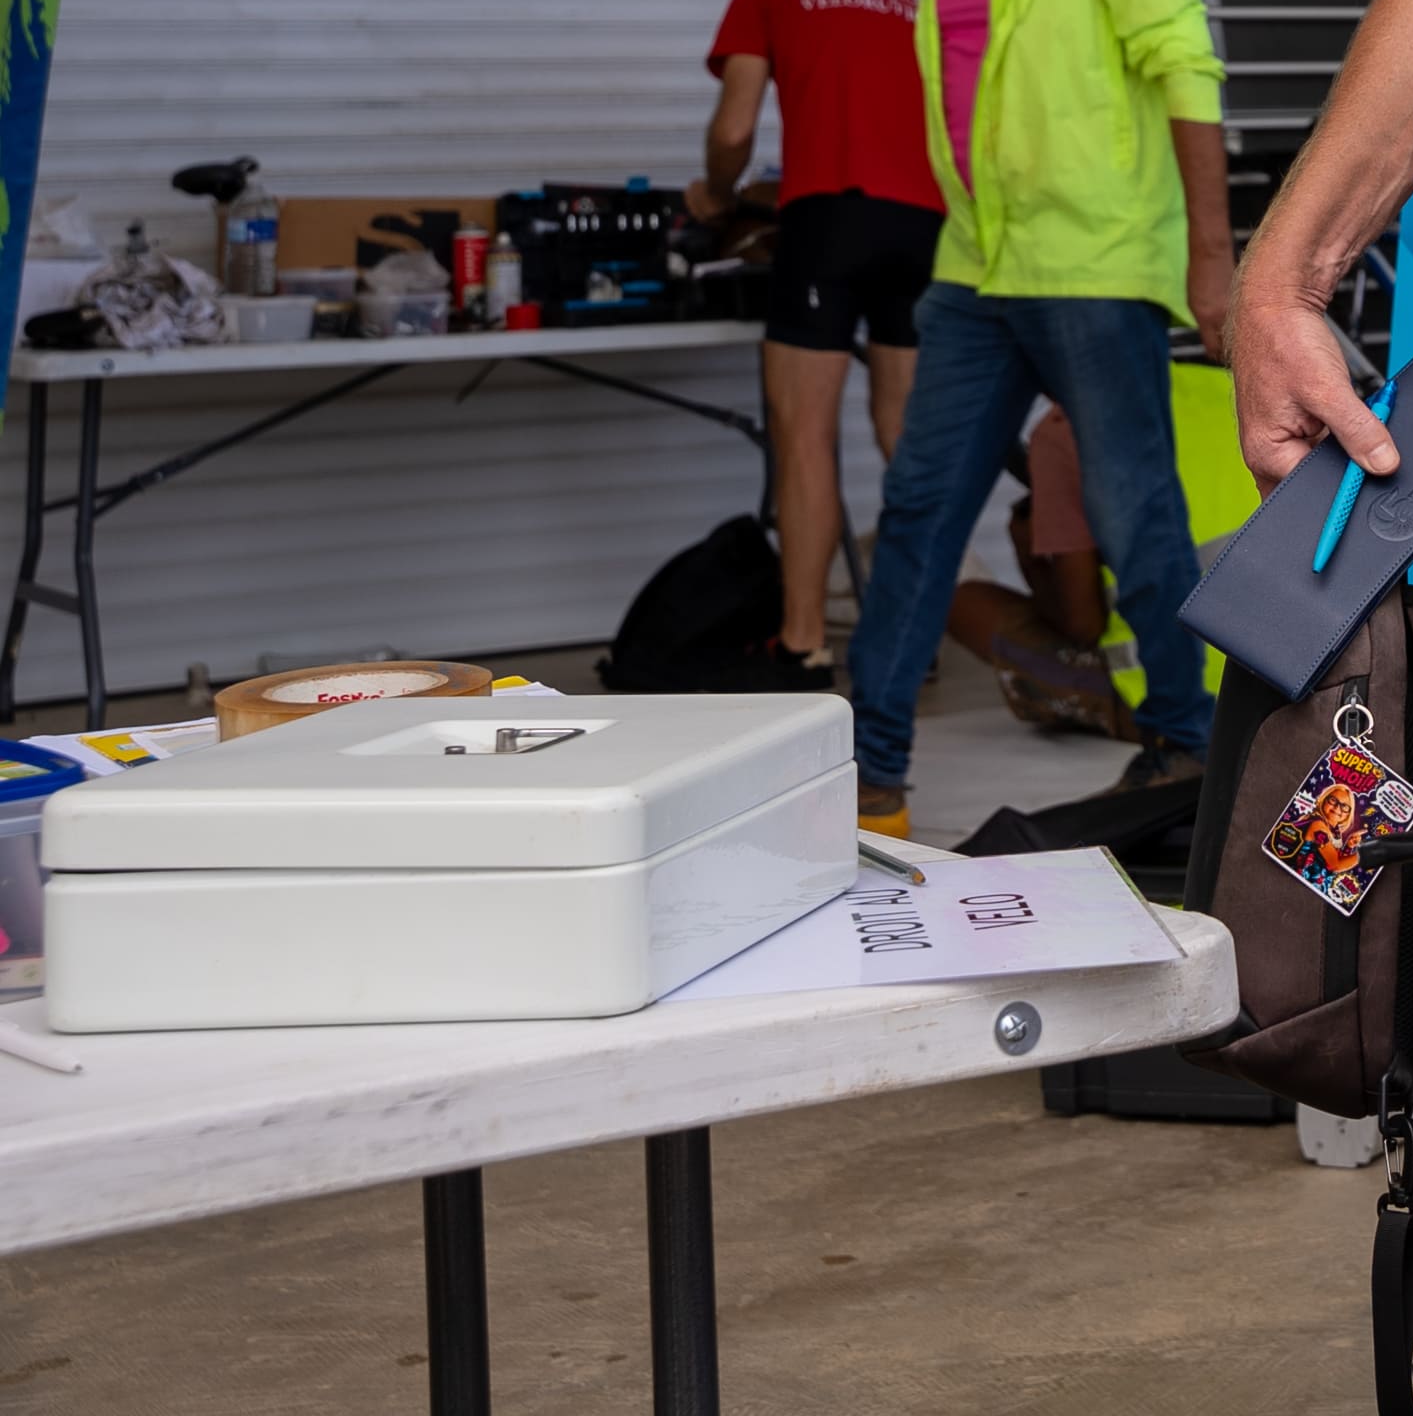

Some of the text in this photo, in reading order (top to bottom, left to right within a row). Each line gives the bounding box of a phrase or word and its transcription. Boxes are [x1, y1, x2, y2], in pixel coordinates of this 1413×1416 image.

[1333, 748, 1373, 775] SUPER
[845, 888, 933, 953] DROIT AU
[959, 893, 1039, 931] VELO
